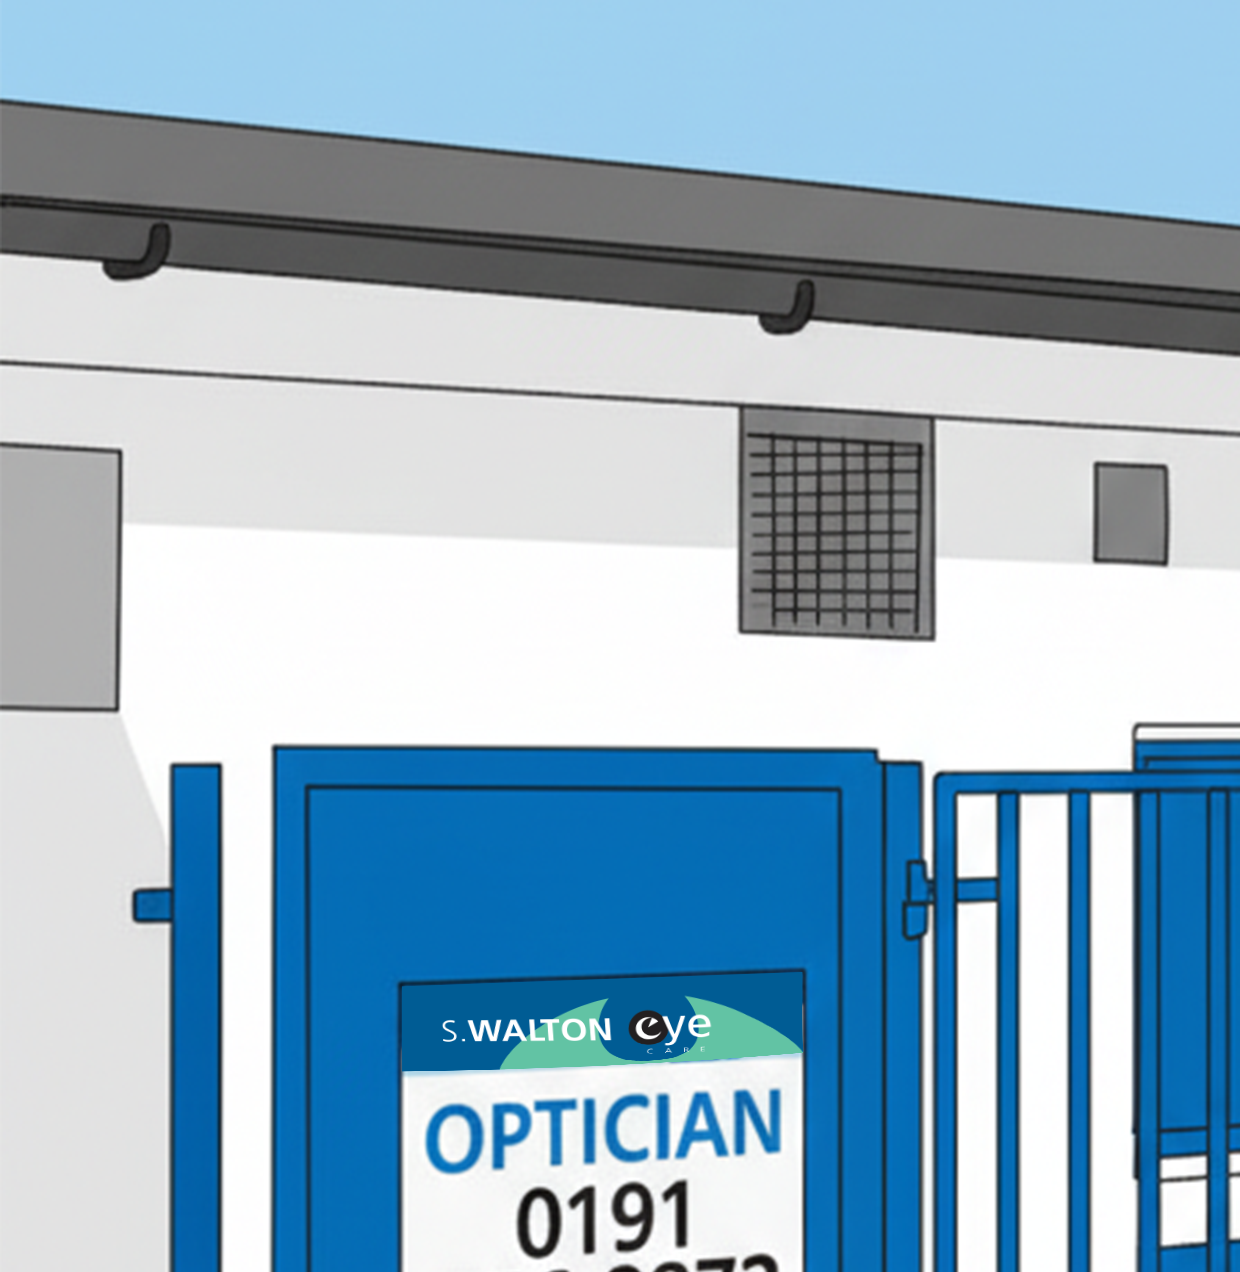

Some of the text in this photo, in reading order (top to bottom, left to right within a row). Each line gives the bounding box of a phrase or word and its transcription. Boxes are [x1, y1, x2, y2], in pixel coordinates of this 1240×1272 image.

[442, 1013, 712, 1046] S.WALTON eye
[646, 1046, 706, 1055] CARE
[425, 1088, 781, 1174] OPTICIAN
[516, 1180, 688, 1259] 0191
